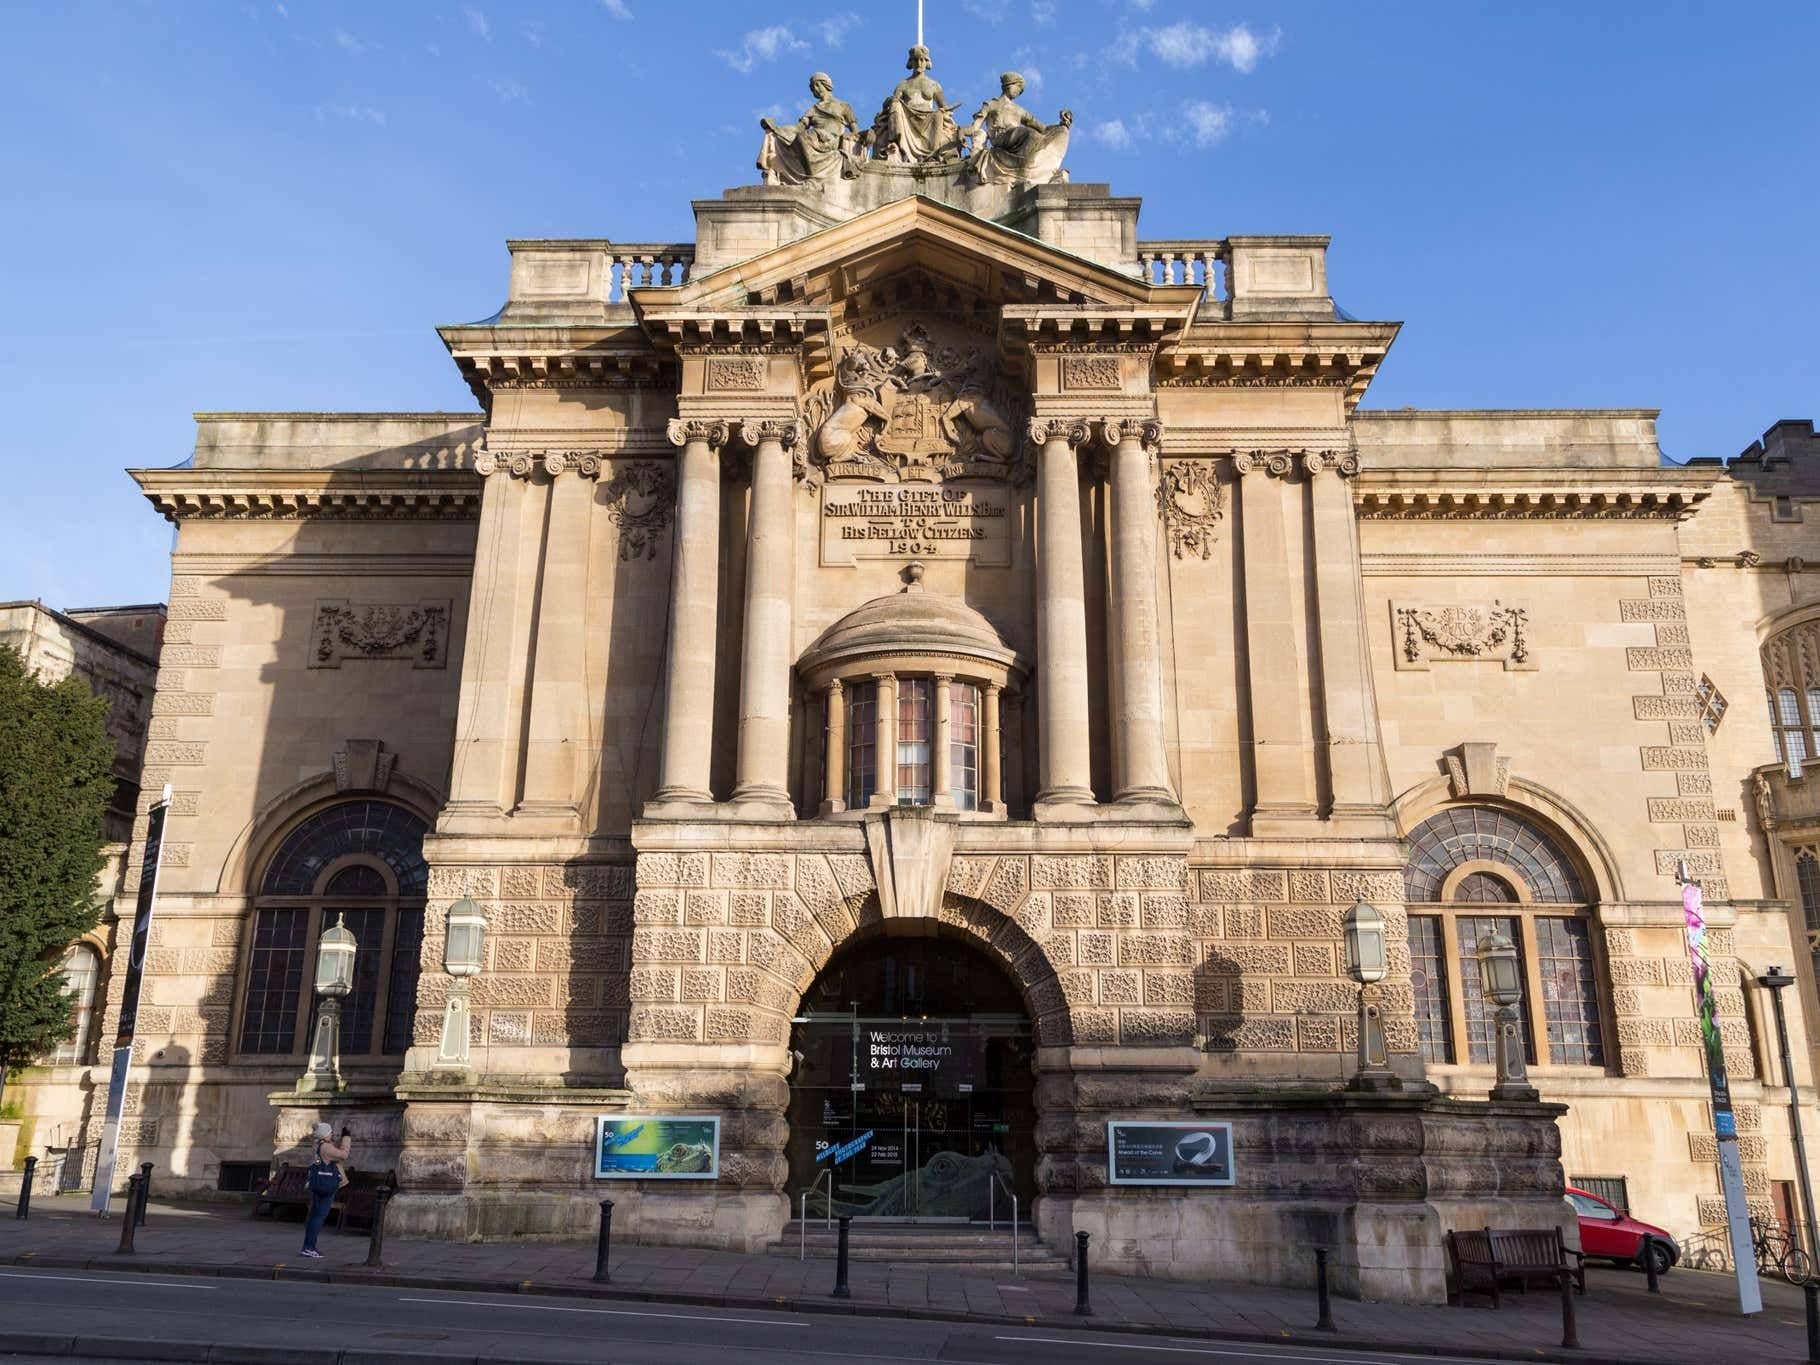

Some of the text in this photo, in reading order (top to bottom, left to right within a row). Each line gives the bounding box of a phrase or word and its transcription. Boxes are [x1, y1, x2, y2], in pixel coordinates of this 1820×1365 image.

[857, 489, 967, 502] THE GIFT OF
[824, 502, 848, 517] SIR
[848, 502, 897, 517] WILLIAM
[899, 502, 942, 517] HENRY
[943, 502, 981, 517] WILLS
[900, 518, 927, 528] TO
[841, 526, 866, 539] HIS
[867, 526, 920, 539] FELLOW
[889, 540, 937, 554] 1904
[870, 1031, 937, 1043] Welcome to
[870, 1044, 952, 1056] Bristol Museum
[870, 1057, 940, 1070] & Art Gallery
[815, 1141, 829, 1149] 50
